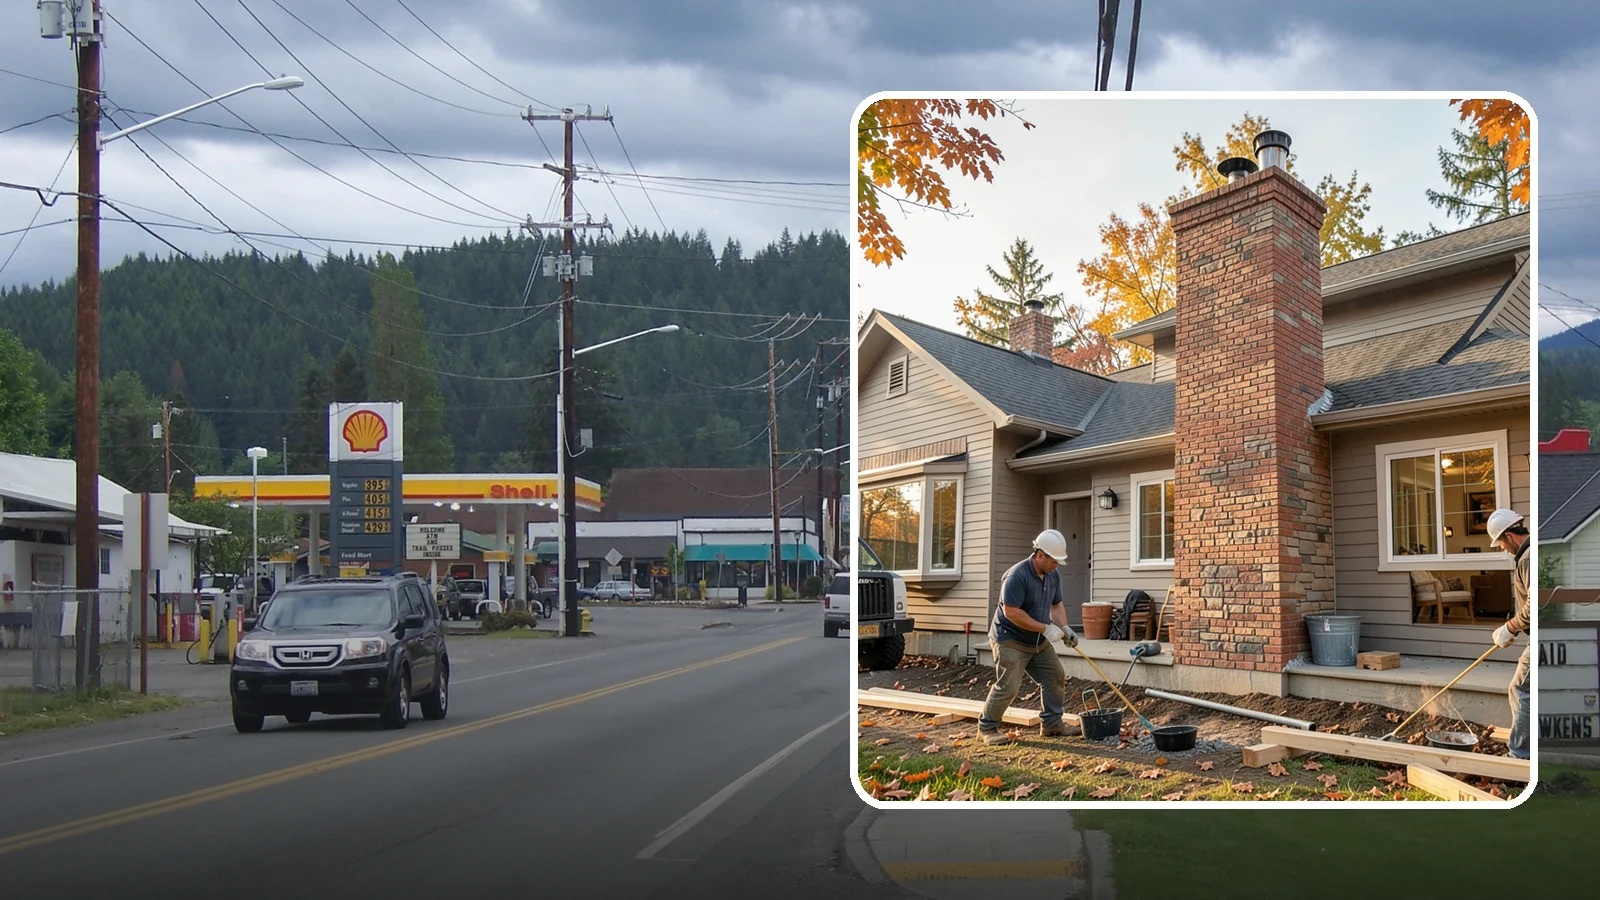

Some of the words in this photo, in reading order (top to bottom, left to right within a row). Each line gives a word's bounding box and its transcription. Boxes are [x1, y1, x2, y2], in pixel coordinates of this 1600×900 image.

[366, 480, 384, 490] 395
[490, 484, 547, 499] Shell
[366, 494, 383, 504] 405
[366, 508, 383, 518] 415
[366, 522, 383, 532] 429
